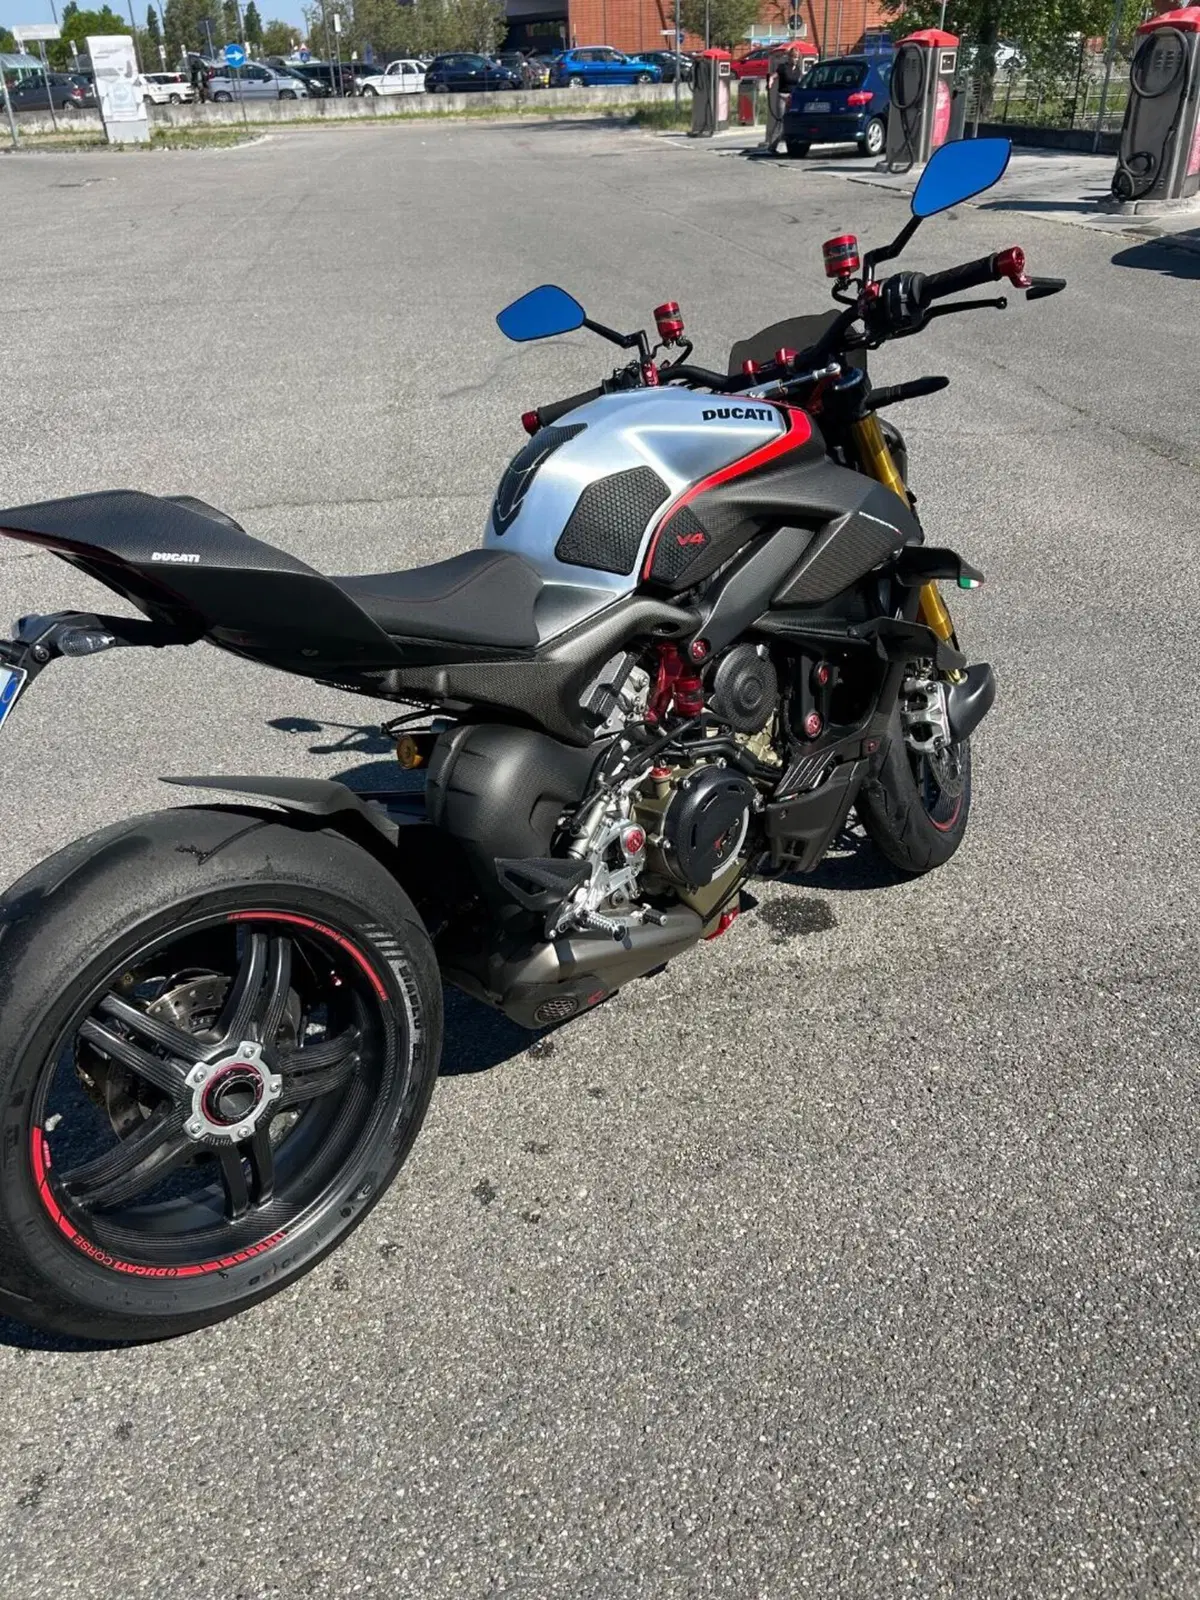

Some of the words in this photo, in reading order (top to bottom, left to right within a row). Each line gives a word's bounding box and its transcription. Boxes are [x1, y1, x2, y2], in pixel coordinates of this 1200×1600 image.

[702, 408, 773, 421] DUCATI
[676, 532, 705, 546] V4
[151, 551, 200, 563] DUCATI
[73, 1235, 113, 1266] CORSE
[113, 1260, 168, 1277] DUCATI
